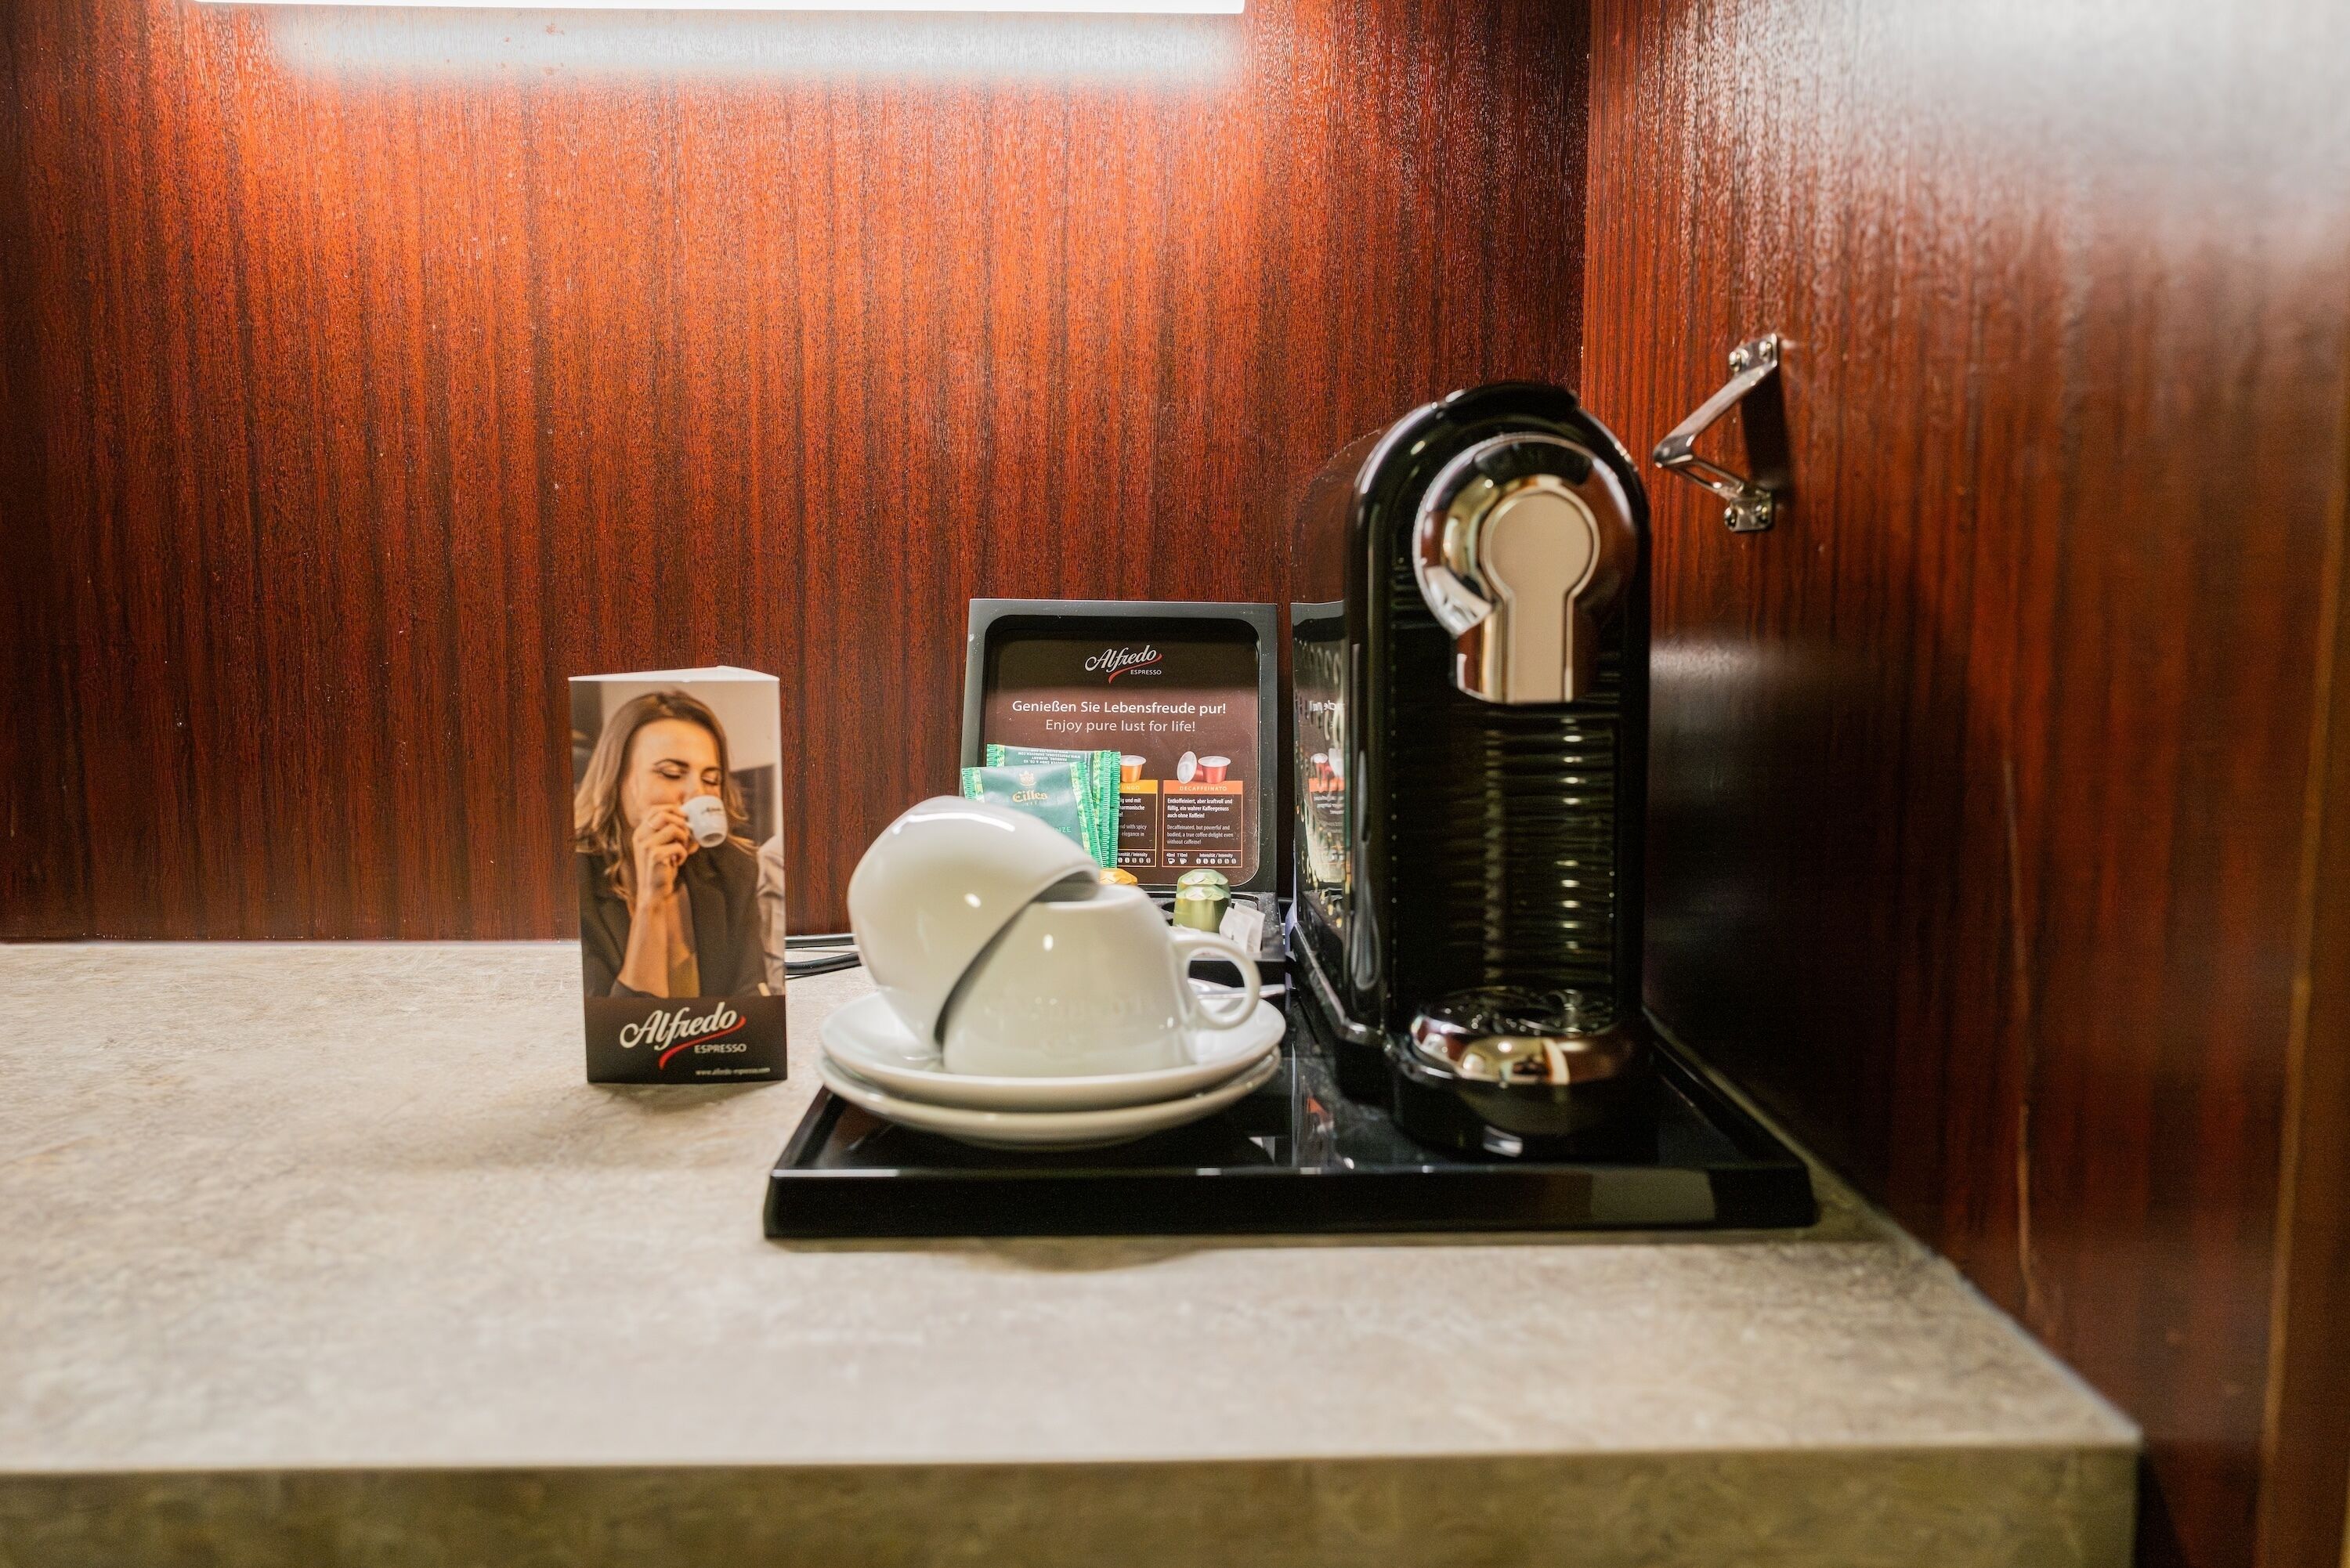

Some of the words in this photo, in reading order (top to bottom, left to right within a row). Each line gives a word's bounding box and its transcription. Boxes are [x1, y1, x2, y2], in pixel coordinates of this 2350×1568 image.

[1084, 645, 1157, 673] Alfredo
[1012, 700, 1076, 712] Genießen
[1081, 702, 1101, 713] Sie
[1104, 702, 1195, 714] Lebensfreude
[1199, 703, 1226, 717] pur!
[1046, 719, 1083, 733] Enjoy
[1086, 722, 1117, 733] pure
[1121, 721, 1145, 732] lust
[1149, 721, 1168, 732] for
[1172, 721, 1195, 732] life!
[1012, 790, 1048, 803] Eilles
[619, 1001, 738, 1051] Alfredo
[694, 1043, 747, 1053] ESPRESSO
